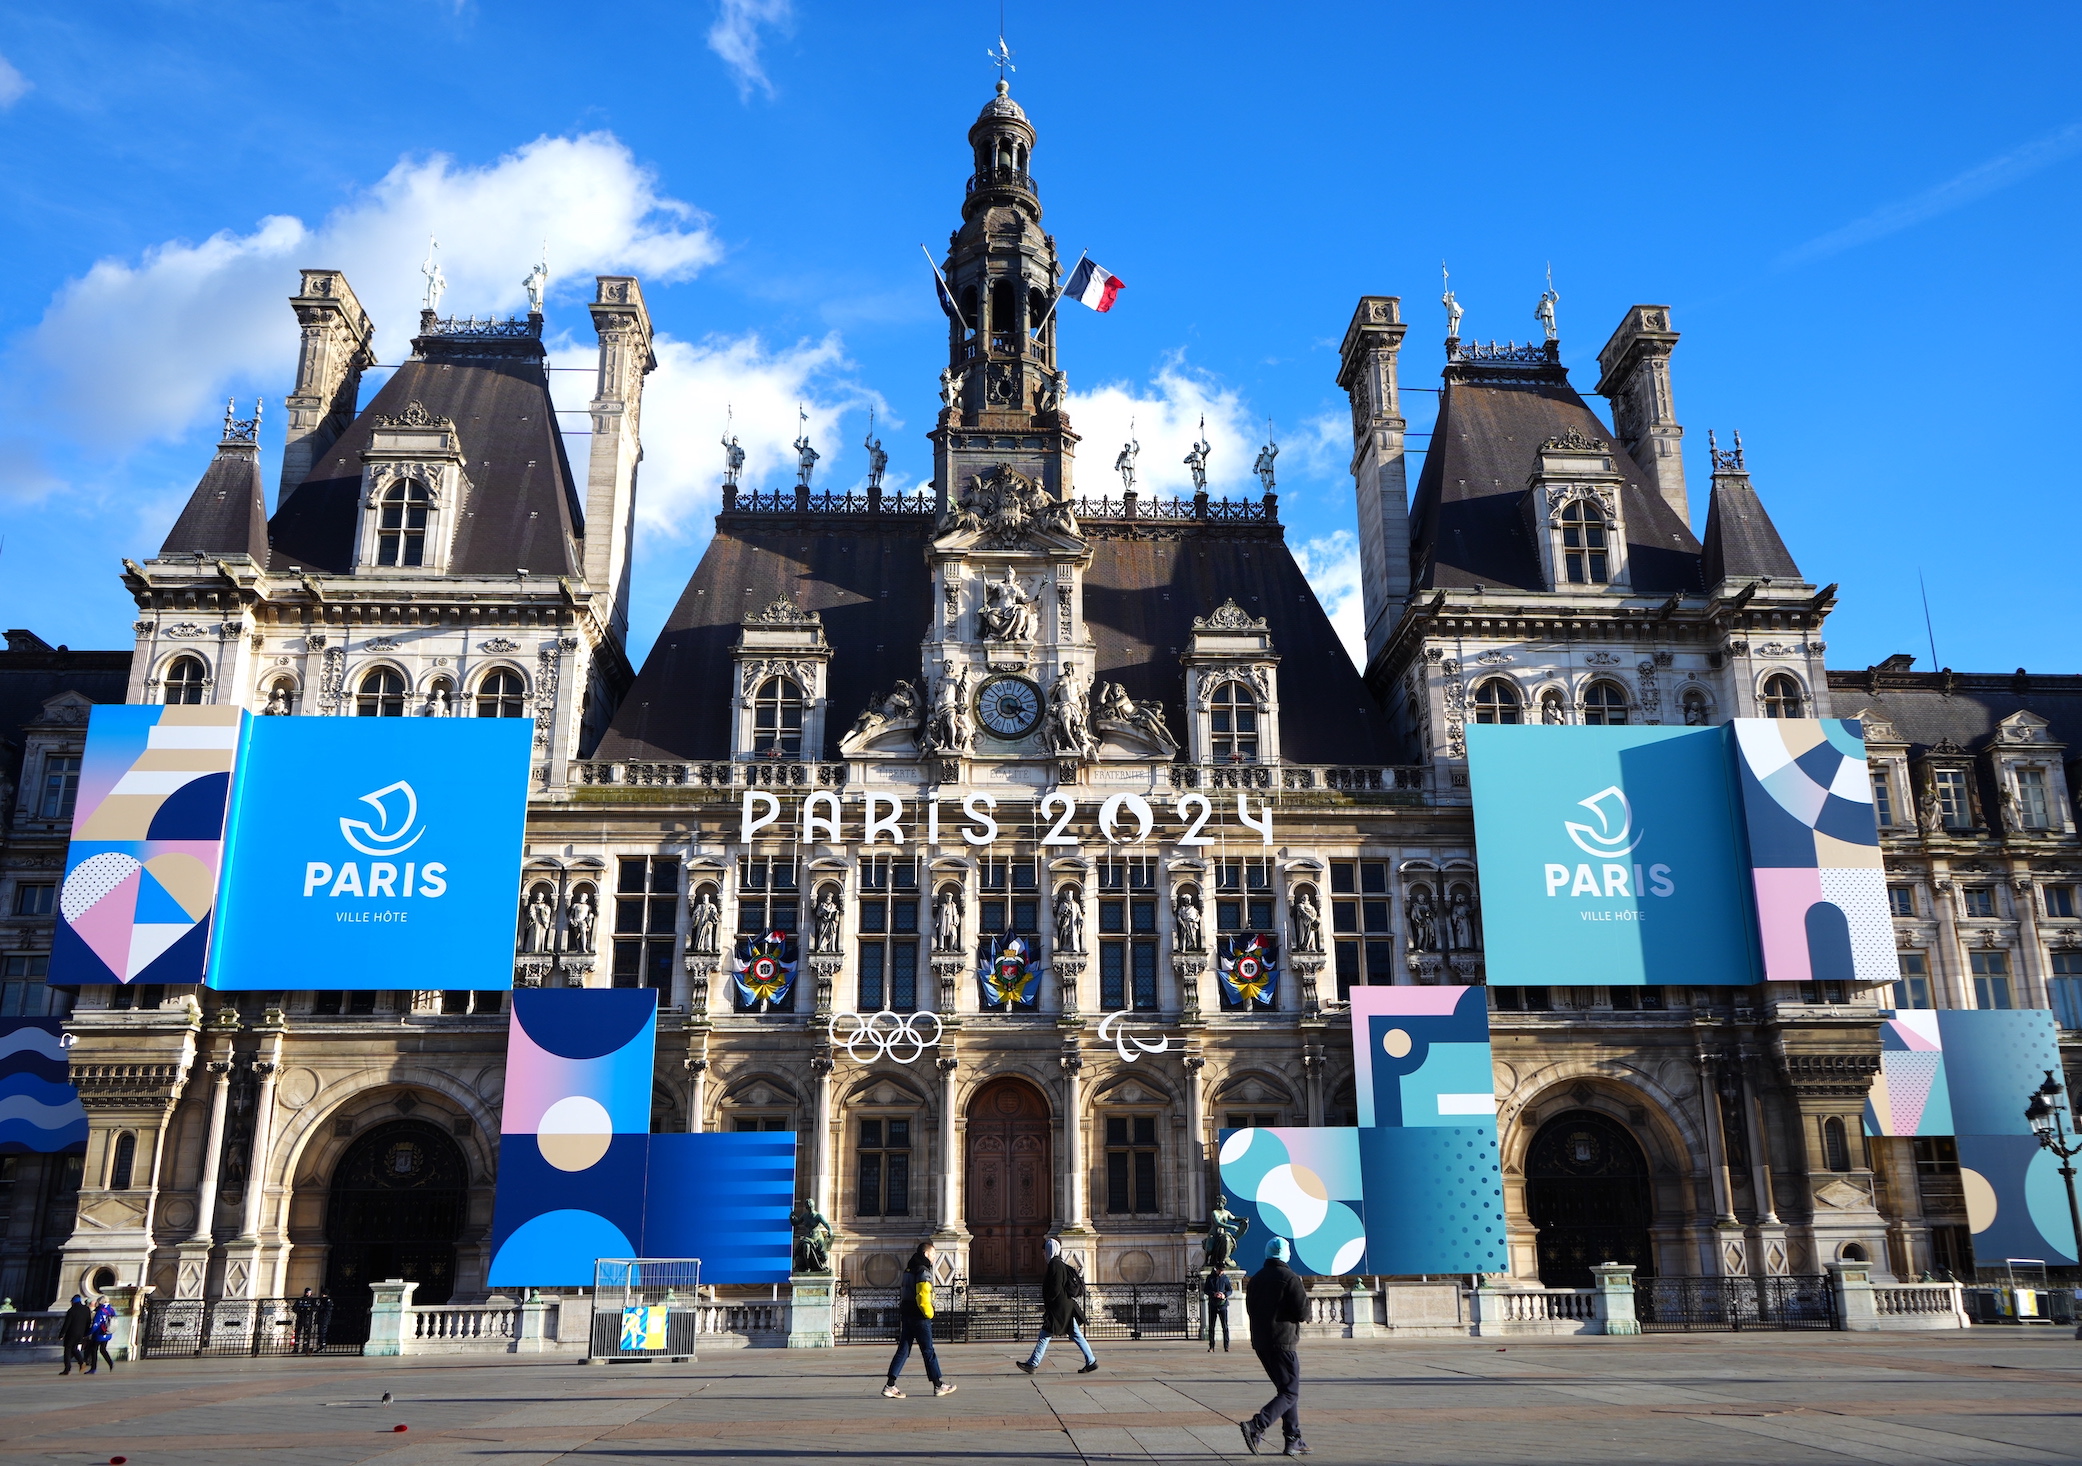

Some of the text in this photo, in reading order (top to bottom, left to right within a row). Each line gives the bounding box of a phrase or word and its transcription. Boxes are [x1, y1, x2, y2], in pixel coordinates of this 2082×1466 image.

[879, 768, 917, 778] LIBERTÉ
[1094, 770, 1145, 780] FRATERNITÉ
[1040, 792, 1273, 846] 2024
[303, 862, 448, 898] PARIS
[1544, 863, 1675, 898] PARIS
[336, 910, 408, 923] VILLE HÔTE
[1580, 909, 1646, 921] VILLE HÔTE
